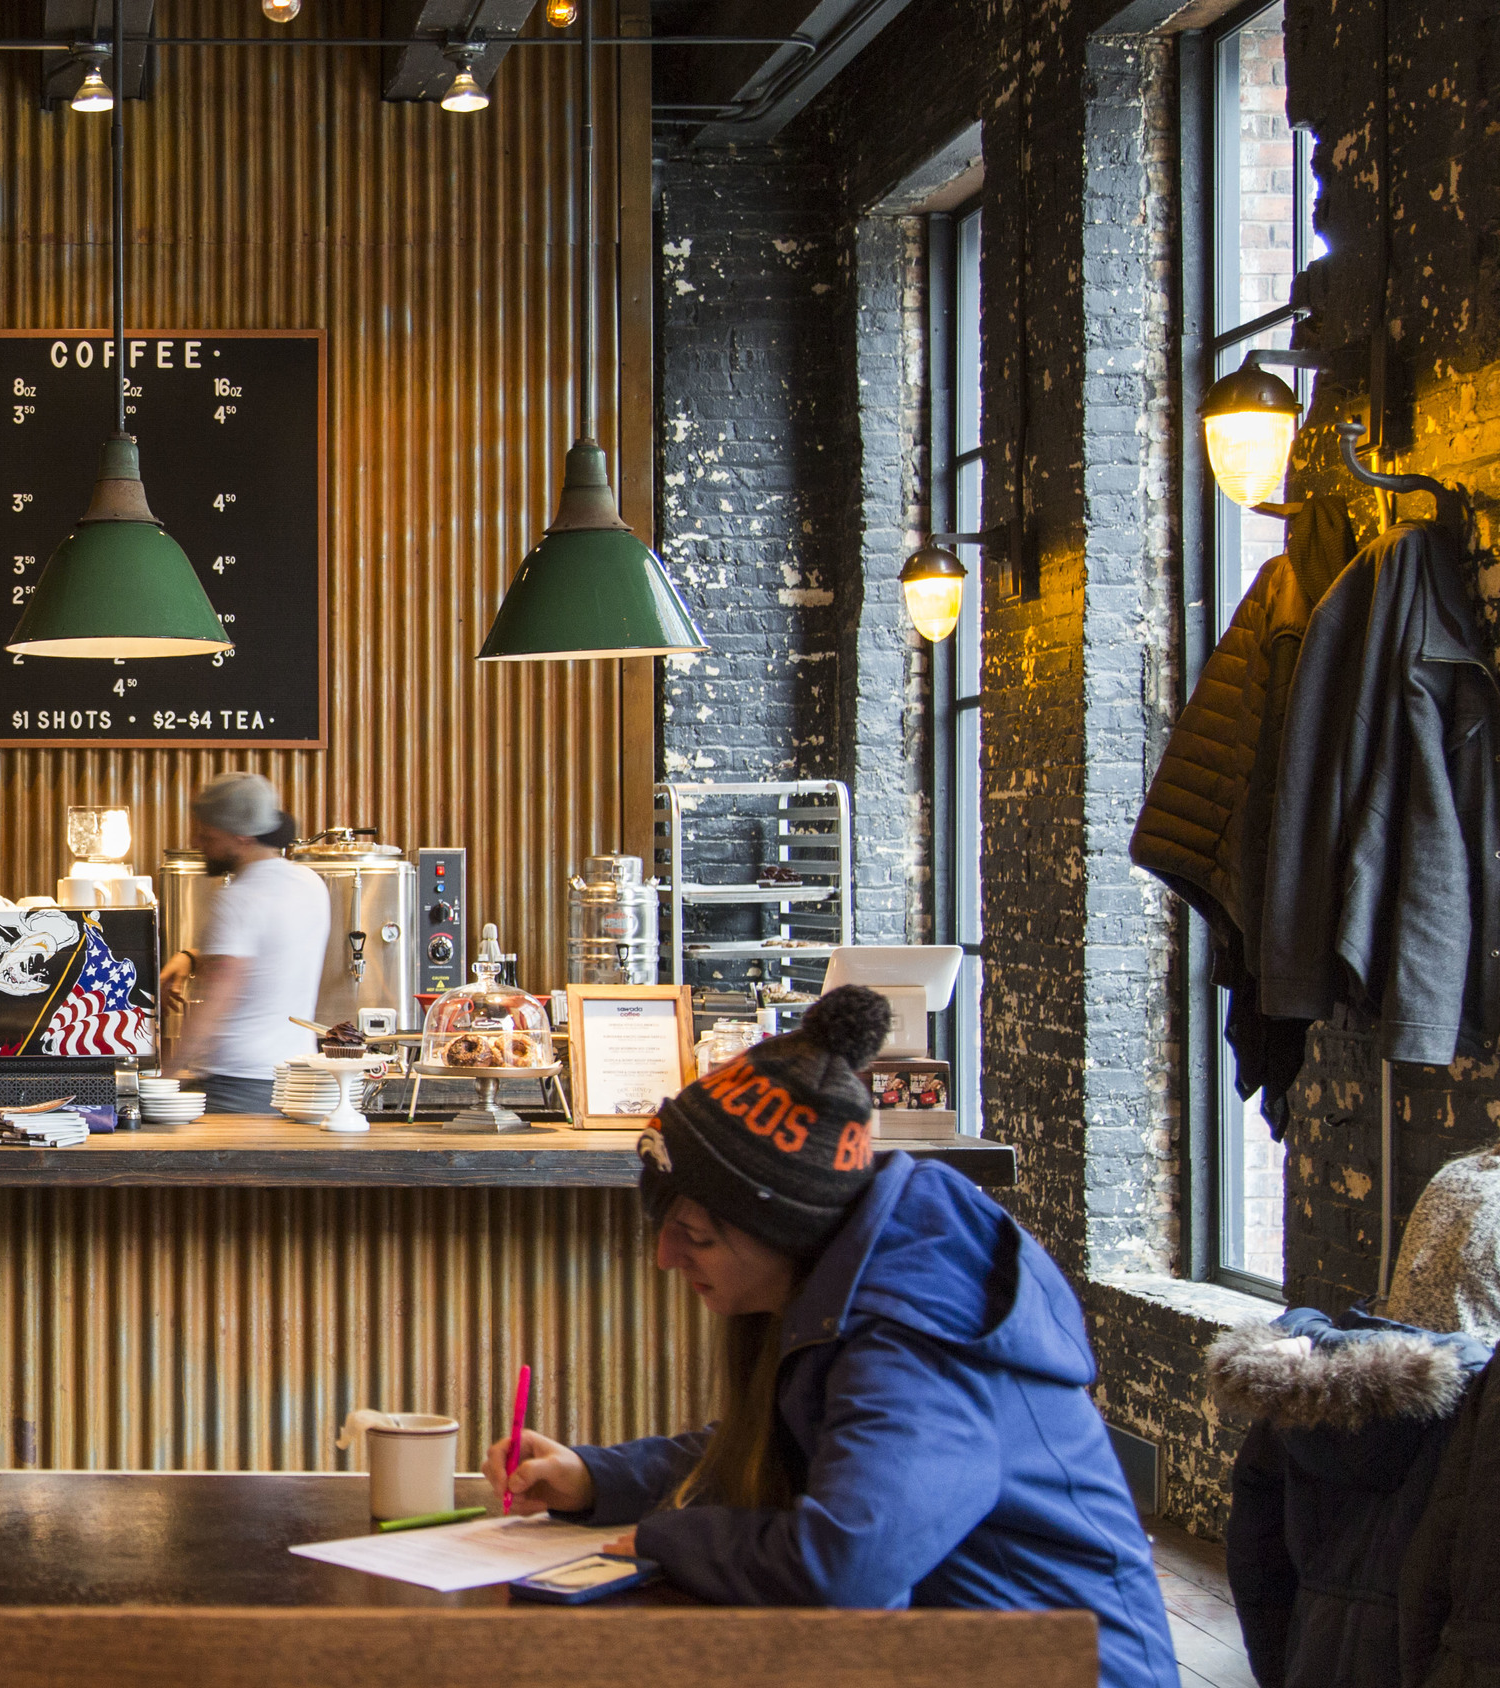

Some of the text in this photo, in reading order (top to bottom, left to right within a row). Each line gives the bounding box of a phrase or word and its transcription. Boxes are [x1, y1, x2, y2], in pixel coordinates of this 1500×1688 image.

[51, 340, 202, 369] COFFEE
[12, 710, 112, 731] $1 SHOTS
[219, 710, 265, 730] TEA
[699, 1056, 819, 1154] NCOS
